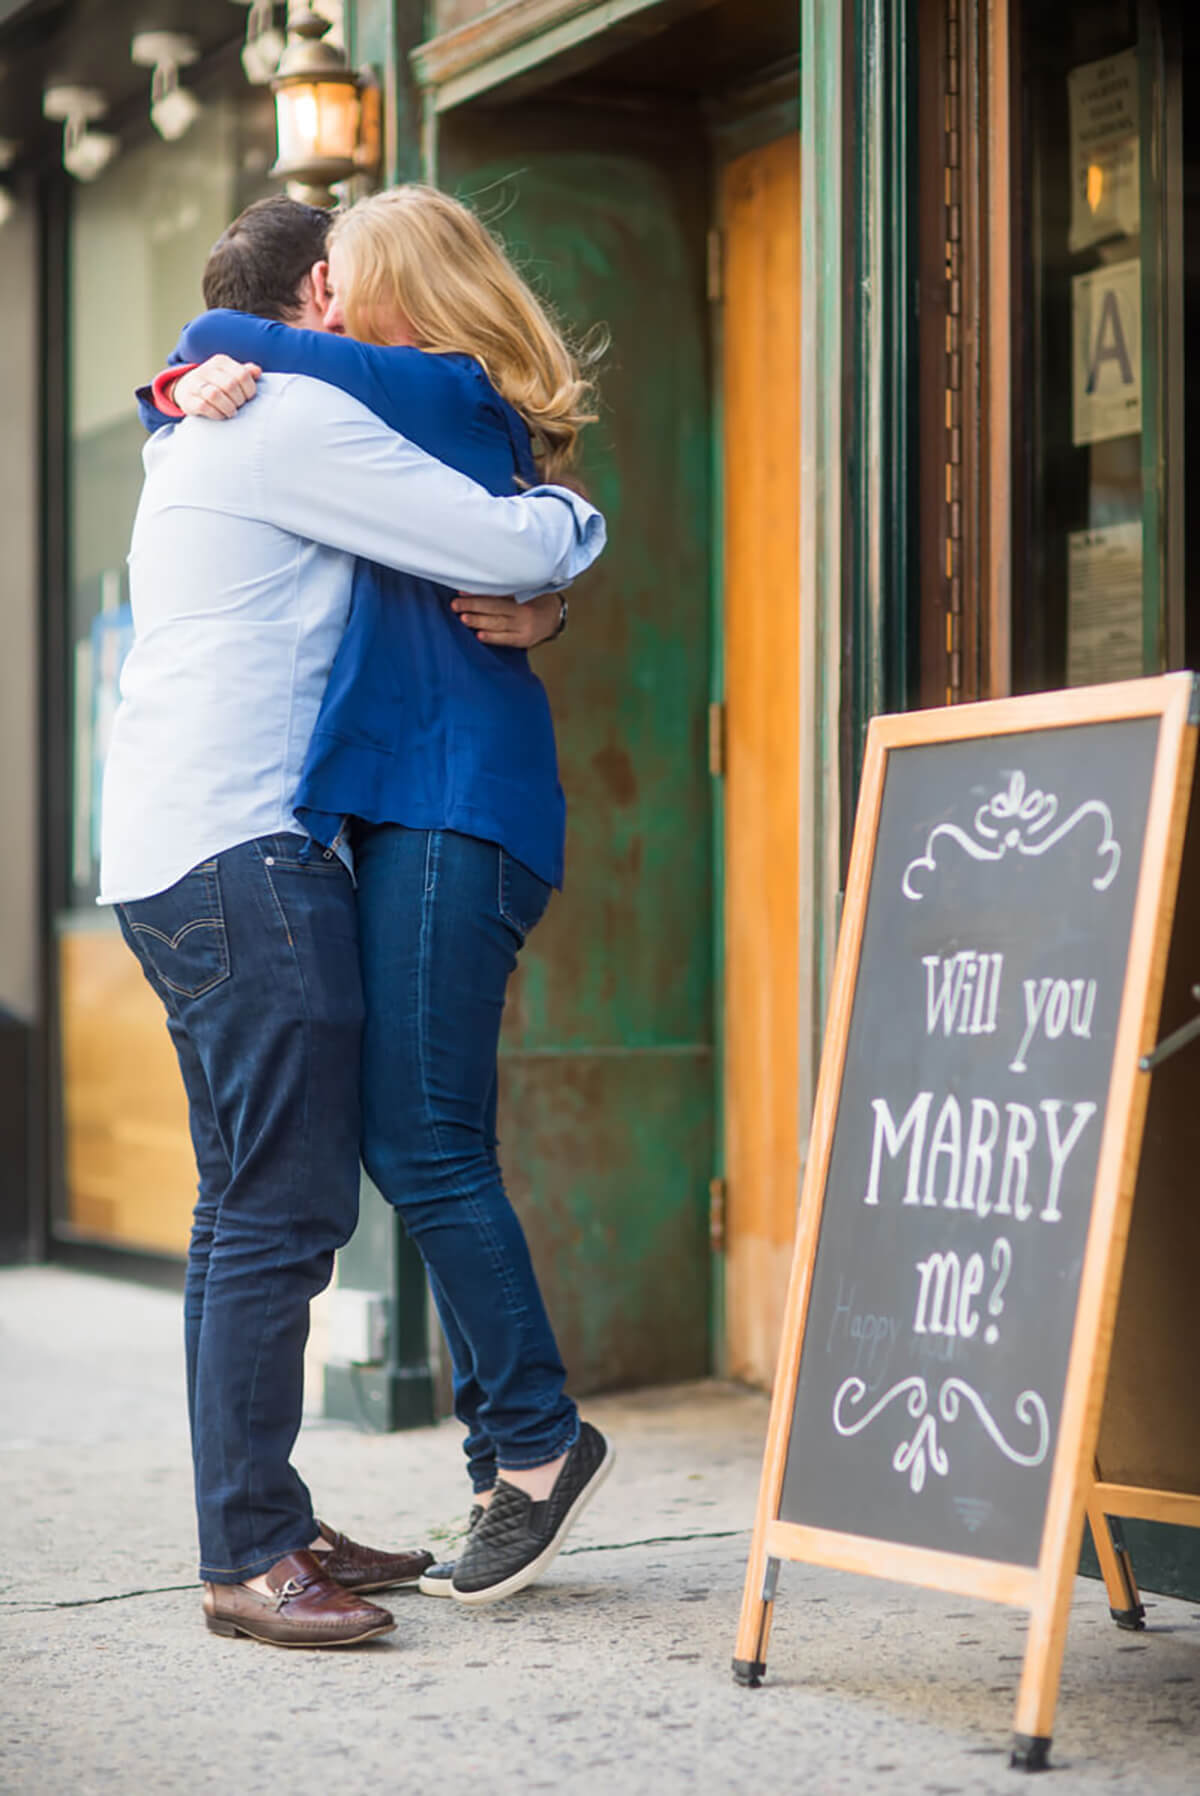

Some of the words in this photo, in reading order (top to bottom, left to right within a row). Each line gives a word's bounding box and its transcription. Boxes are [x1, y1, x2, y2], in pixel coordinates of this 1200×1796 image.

[1086, 288, 1134, 395] A
[921, 950, 1004, 1037] Will
[1008, 977, 1097, 1073] you
[863, 1091, 1098, 1223] MARRY
[913, 1237, 1012, 1345] me?
